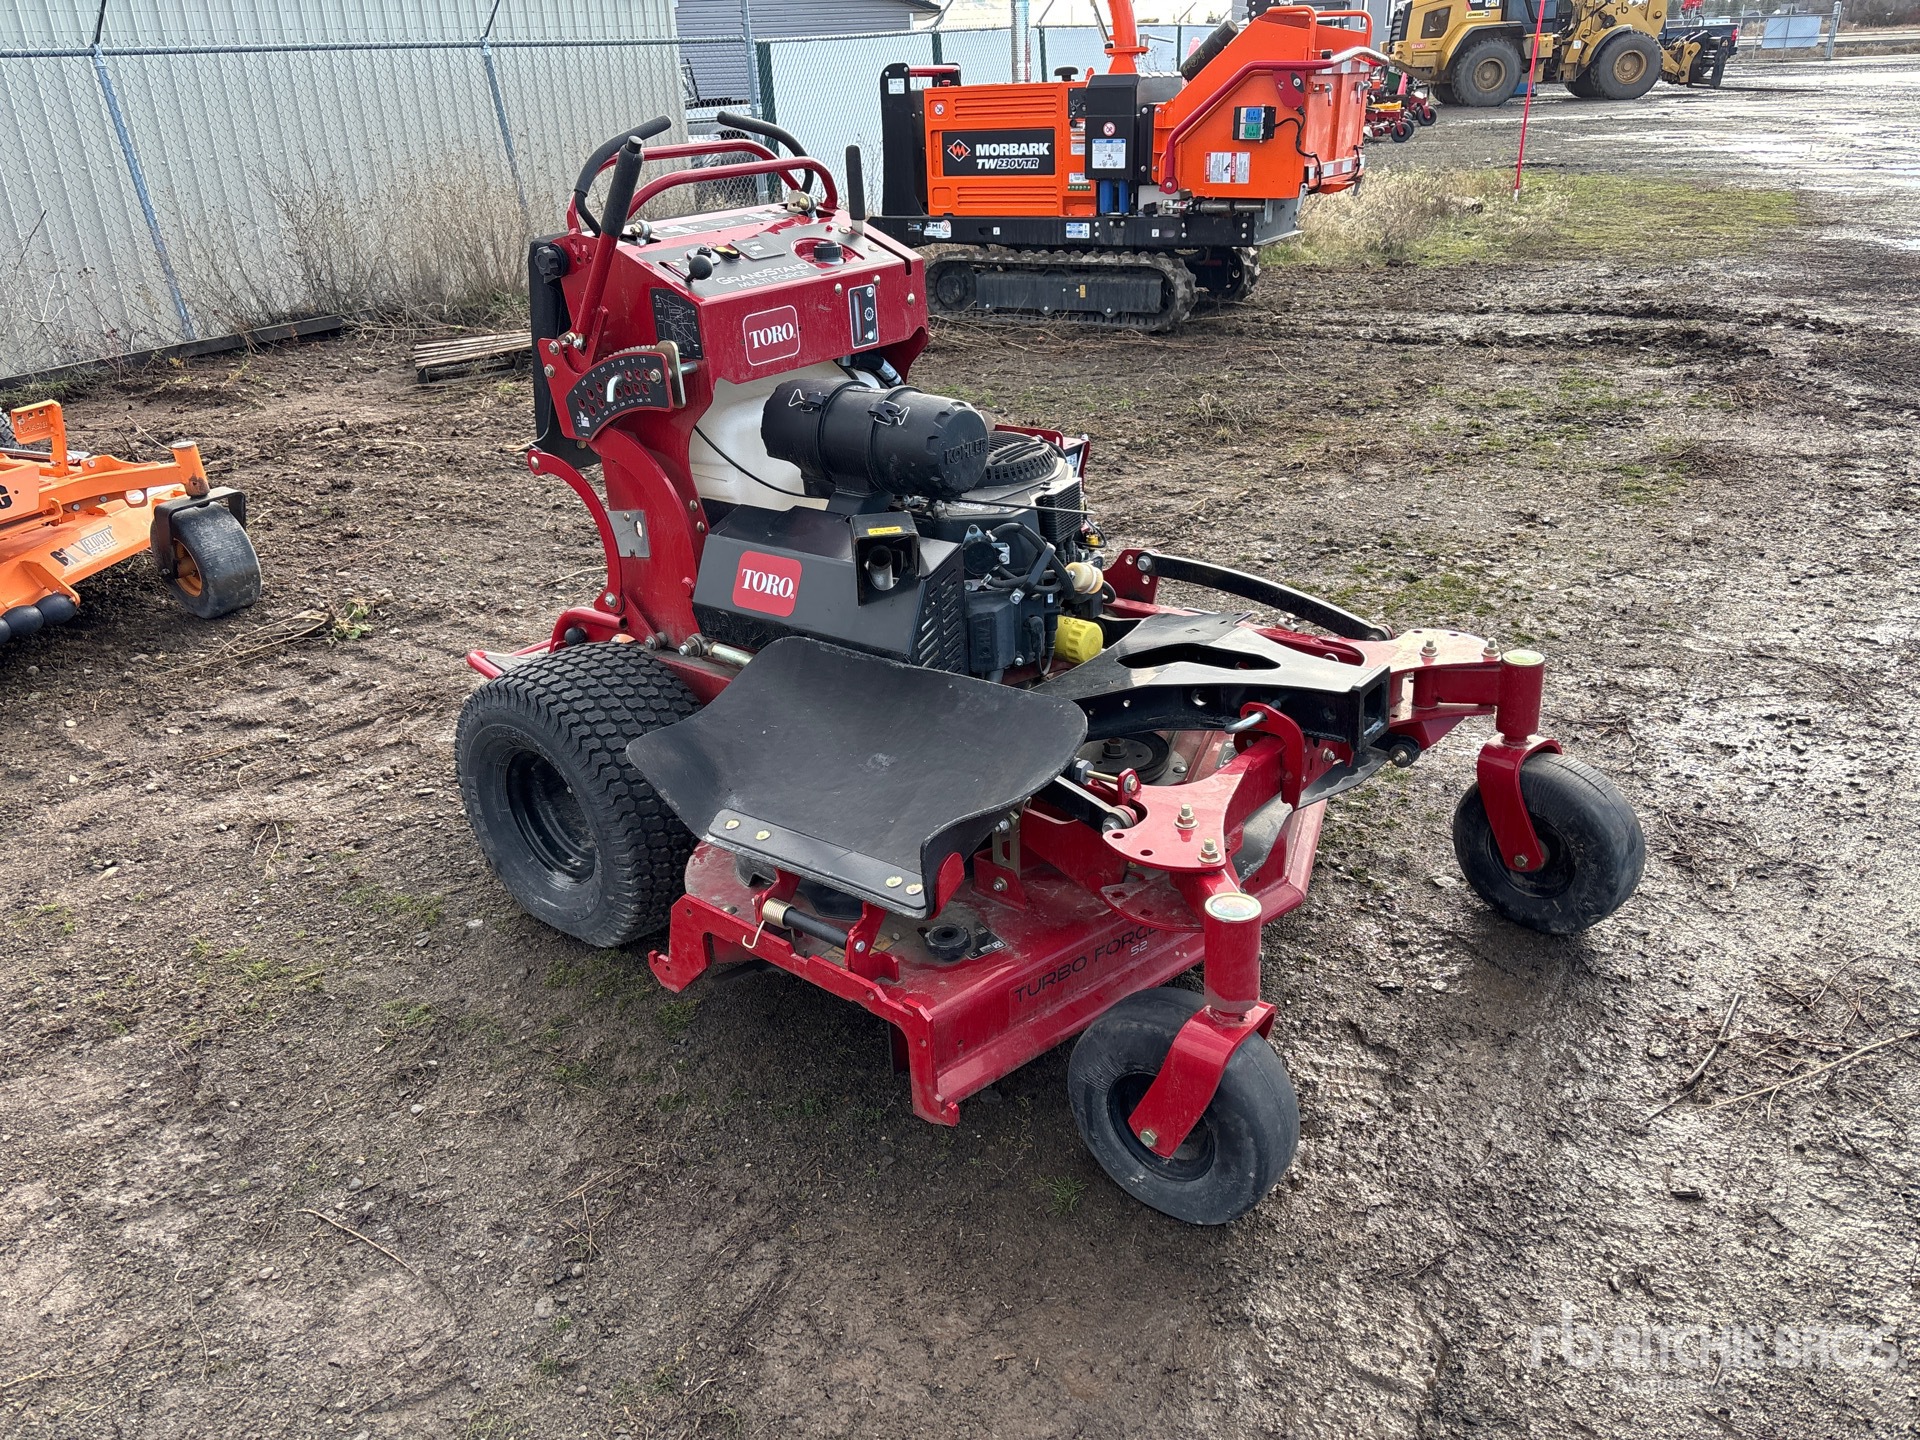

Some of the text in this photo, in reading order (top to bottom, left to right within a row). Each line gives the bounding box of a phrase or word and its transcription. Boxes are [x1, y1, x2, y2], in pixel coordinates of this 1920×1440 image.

[1615, 5, 1629, 16] rb
[976, 143, 1050, 157] MORBARK
[976, 158, 1039, 170] TW230VTR
[738, 271, 810, 288] MULTI FORCE
[749, 322, 794, 349] TORO
[944, 438, 986, 465] KOHLER
[741, 568, 794, 599] TORO
[1130, 940, 1148, 957] 52
[1014, 955, 1088, 1003] TURBO
